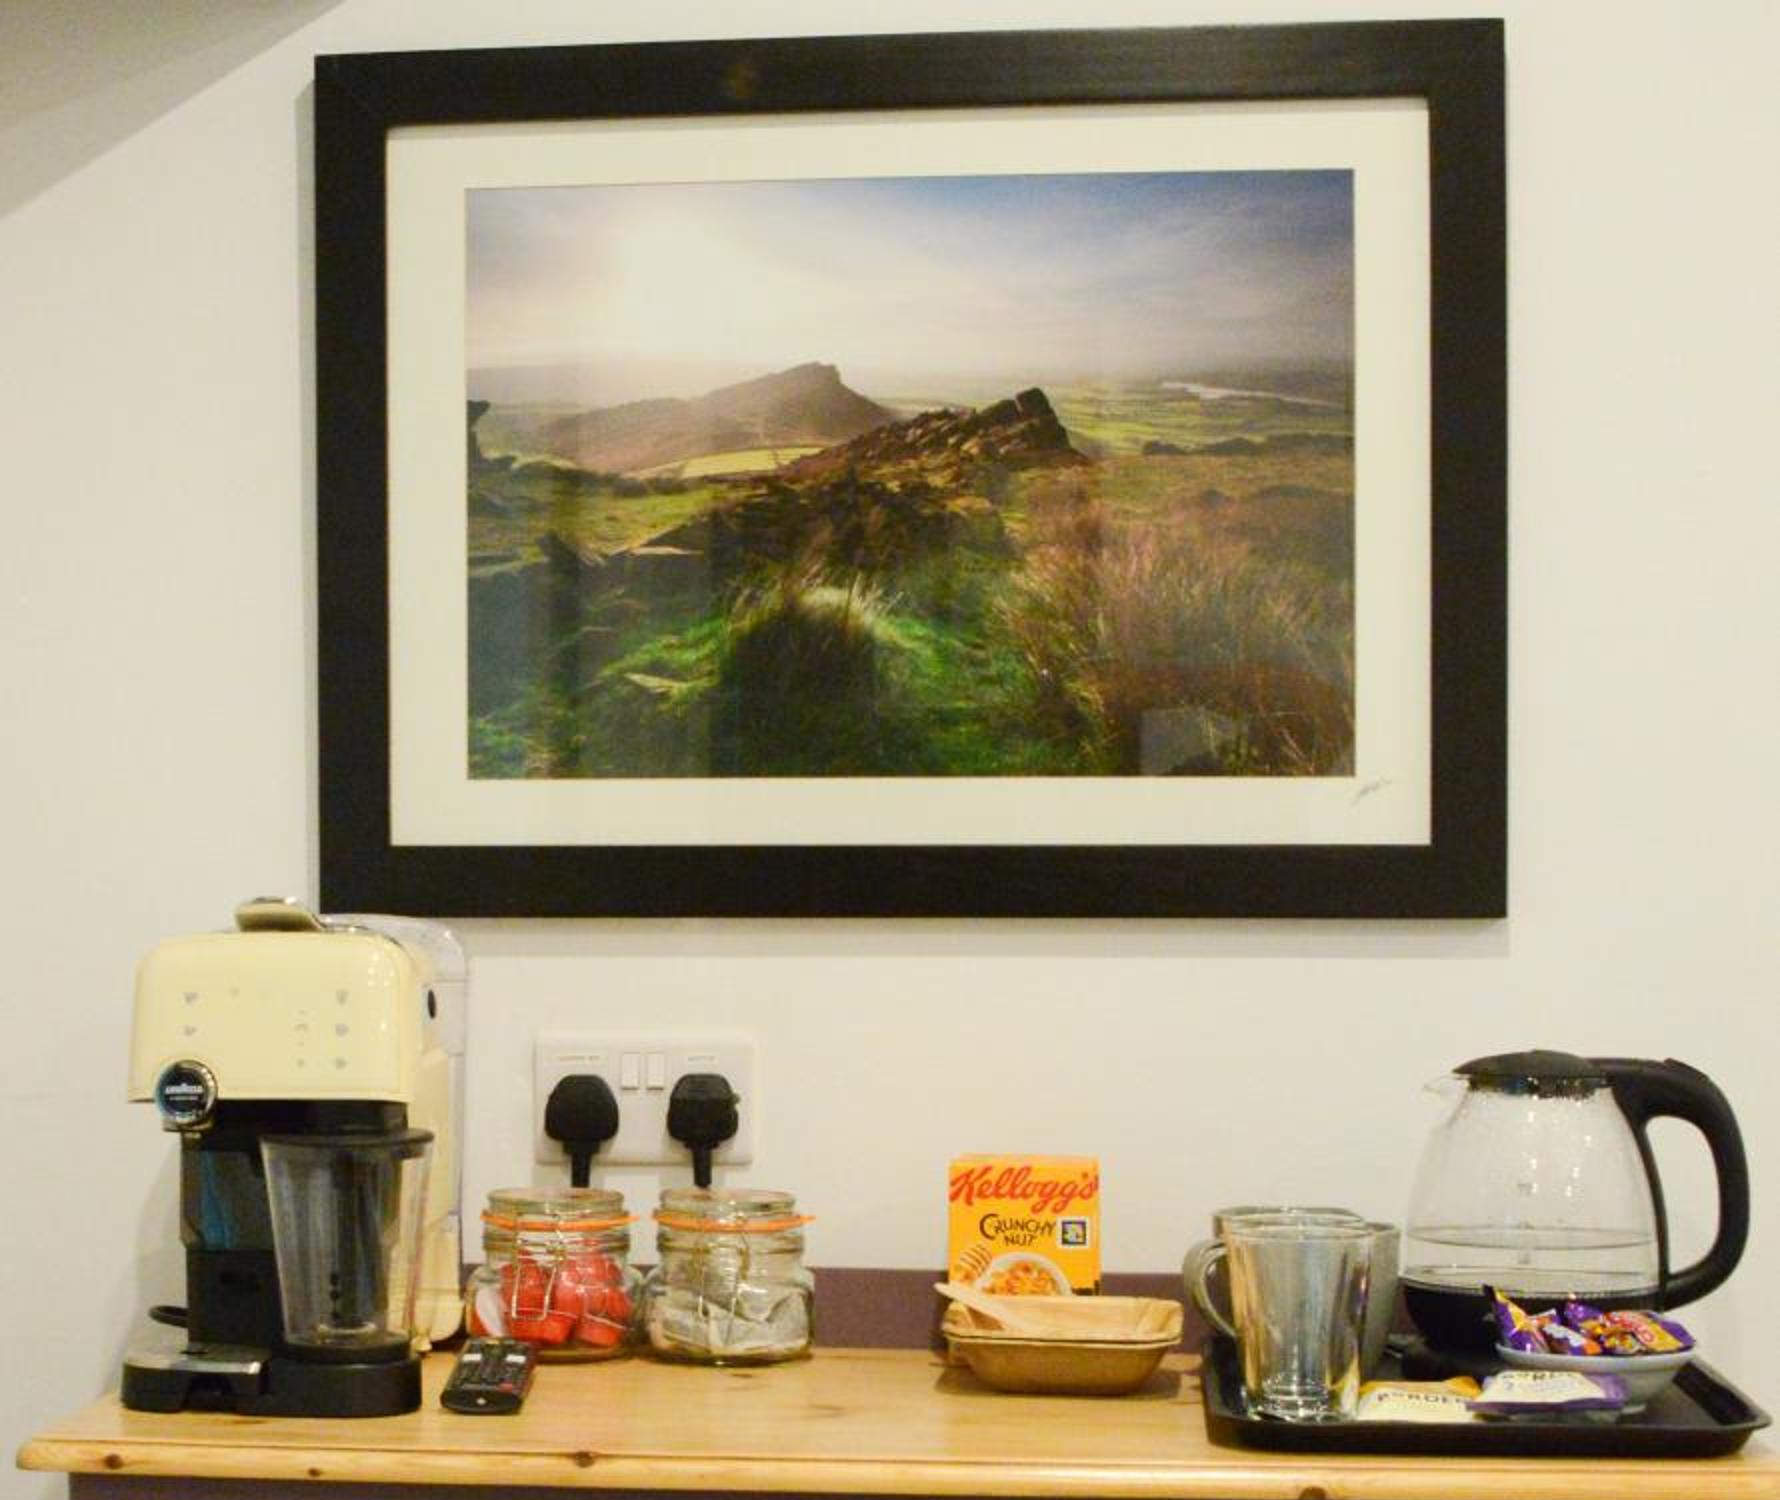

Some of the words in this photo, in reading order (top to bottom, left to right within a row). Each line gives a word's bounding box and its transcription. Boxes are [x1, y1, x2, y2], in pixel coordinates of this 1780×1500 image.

[949, 1165, 1099, 1214] Kellogg's
[979, 1213, 1057, 1240] CRUNCHY
[1003, 1232, 1039, 1247] NUT
